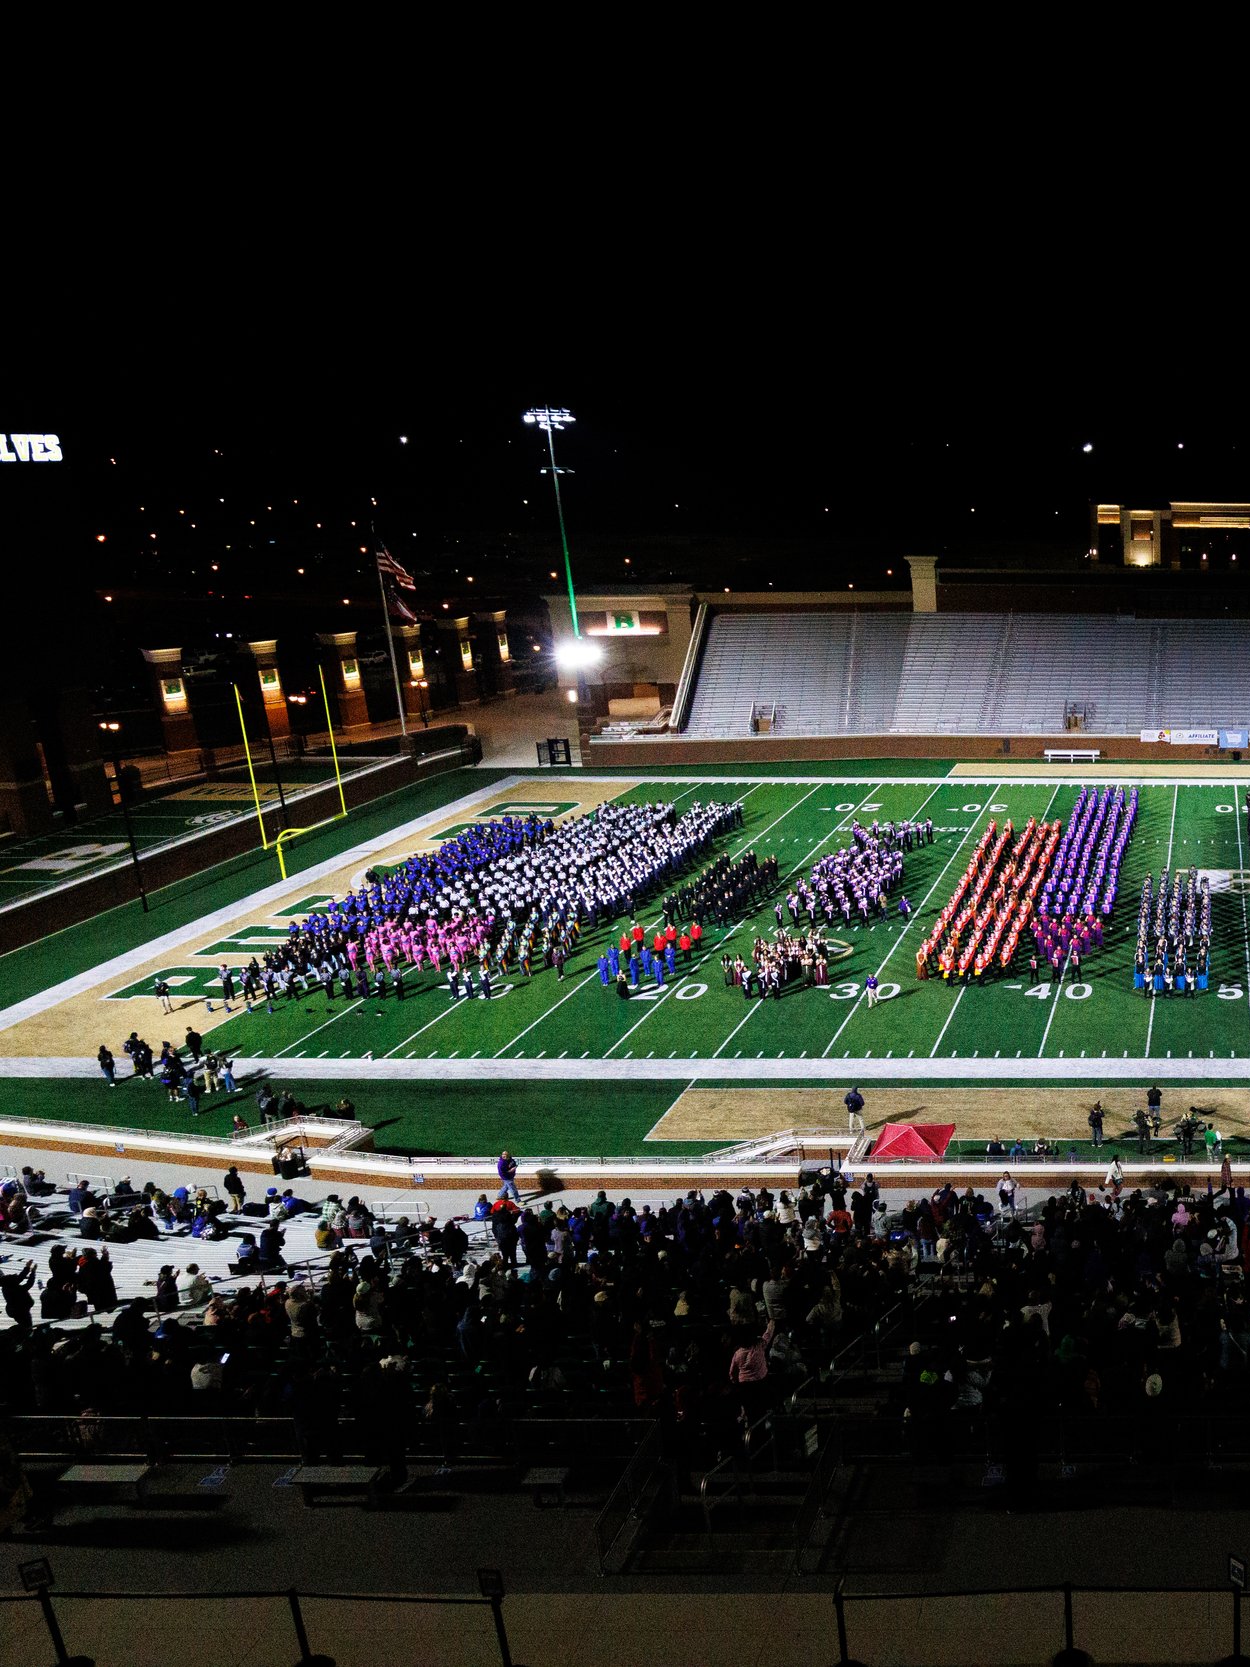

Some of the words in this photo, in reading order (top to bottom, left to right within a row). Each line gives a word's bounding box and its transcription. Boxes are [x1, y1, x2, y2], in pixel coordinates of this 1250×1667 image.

[629, 983, 709, 1000] 20
[829, 982, 901, 1000] 30
[1024, 983, 1093, 999] 40
